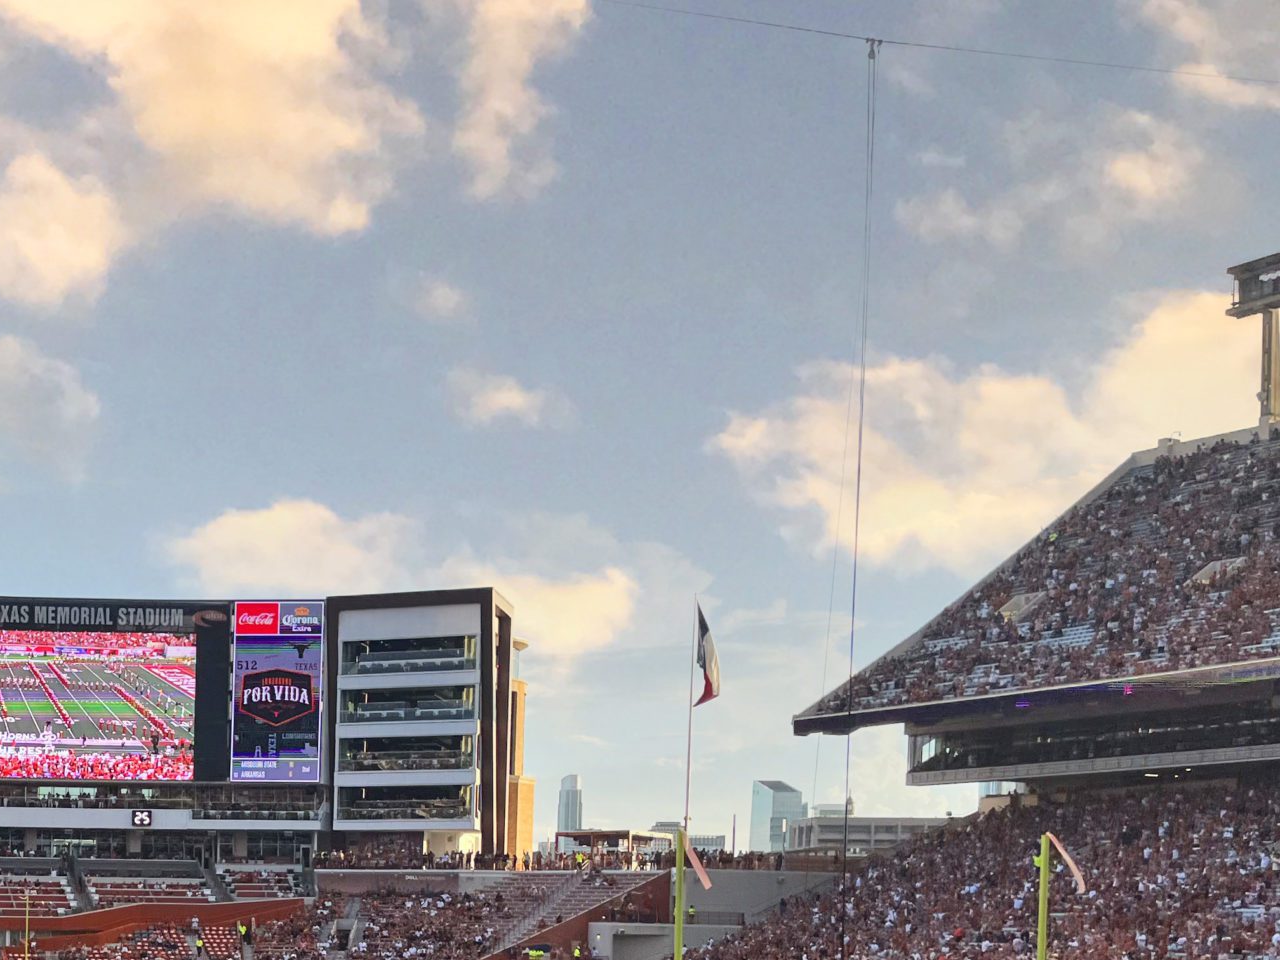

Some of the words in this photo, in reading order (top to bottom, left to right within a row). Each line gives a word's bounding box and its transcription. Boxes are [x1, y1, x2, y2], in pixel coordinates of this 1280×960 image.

[34, 606, 113, 626] MEMORIAL
[117, 608, 184, 627] STADIUM
[282, 614, 320, 626] Corona
[292, 624, 312, 632] Extra
[237, 660, 258, 670] 512
[294, 662, 318, 670] TEXAS
[274, 685, 310, 705] VIDA
[134, 811, 150, 825] 25
